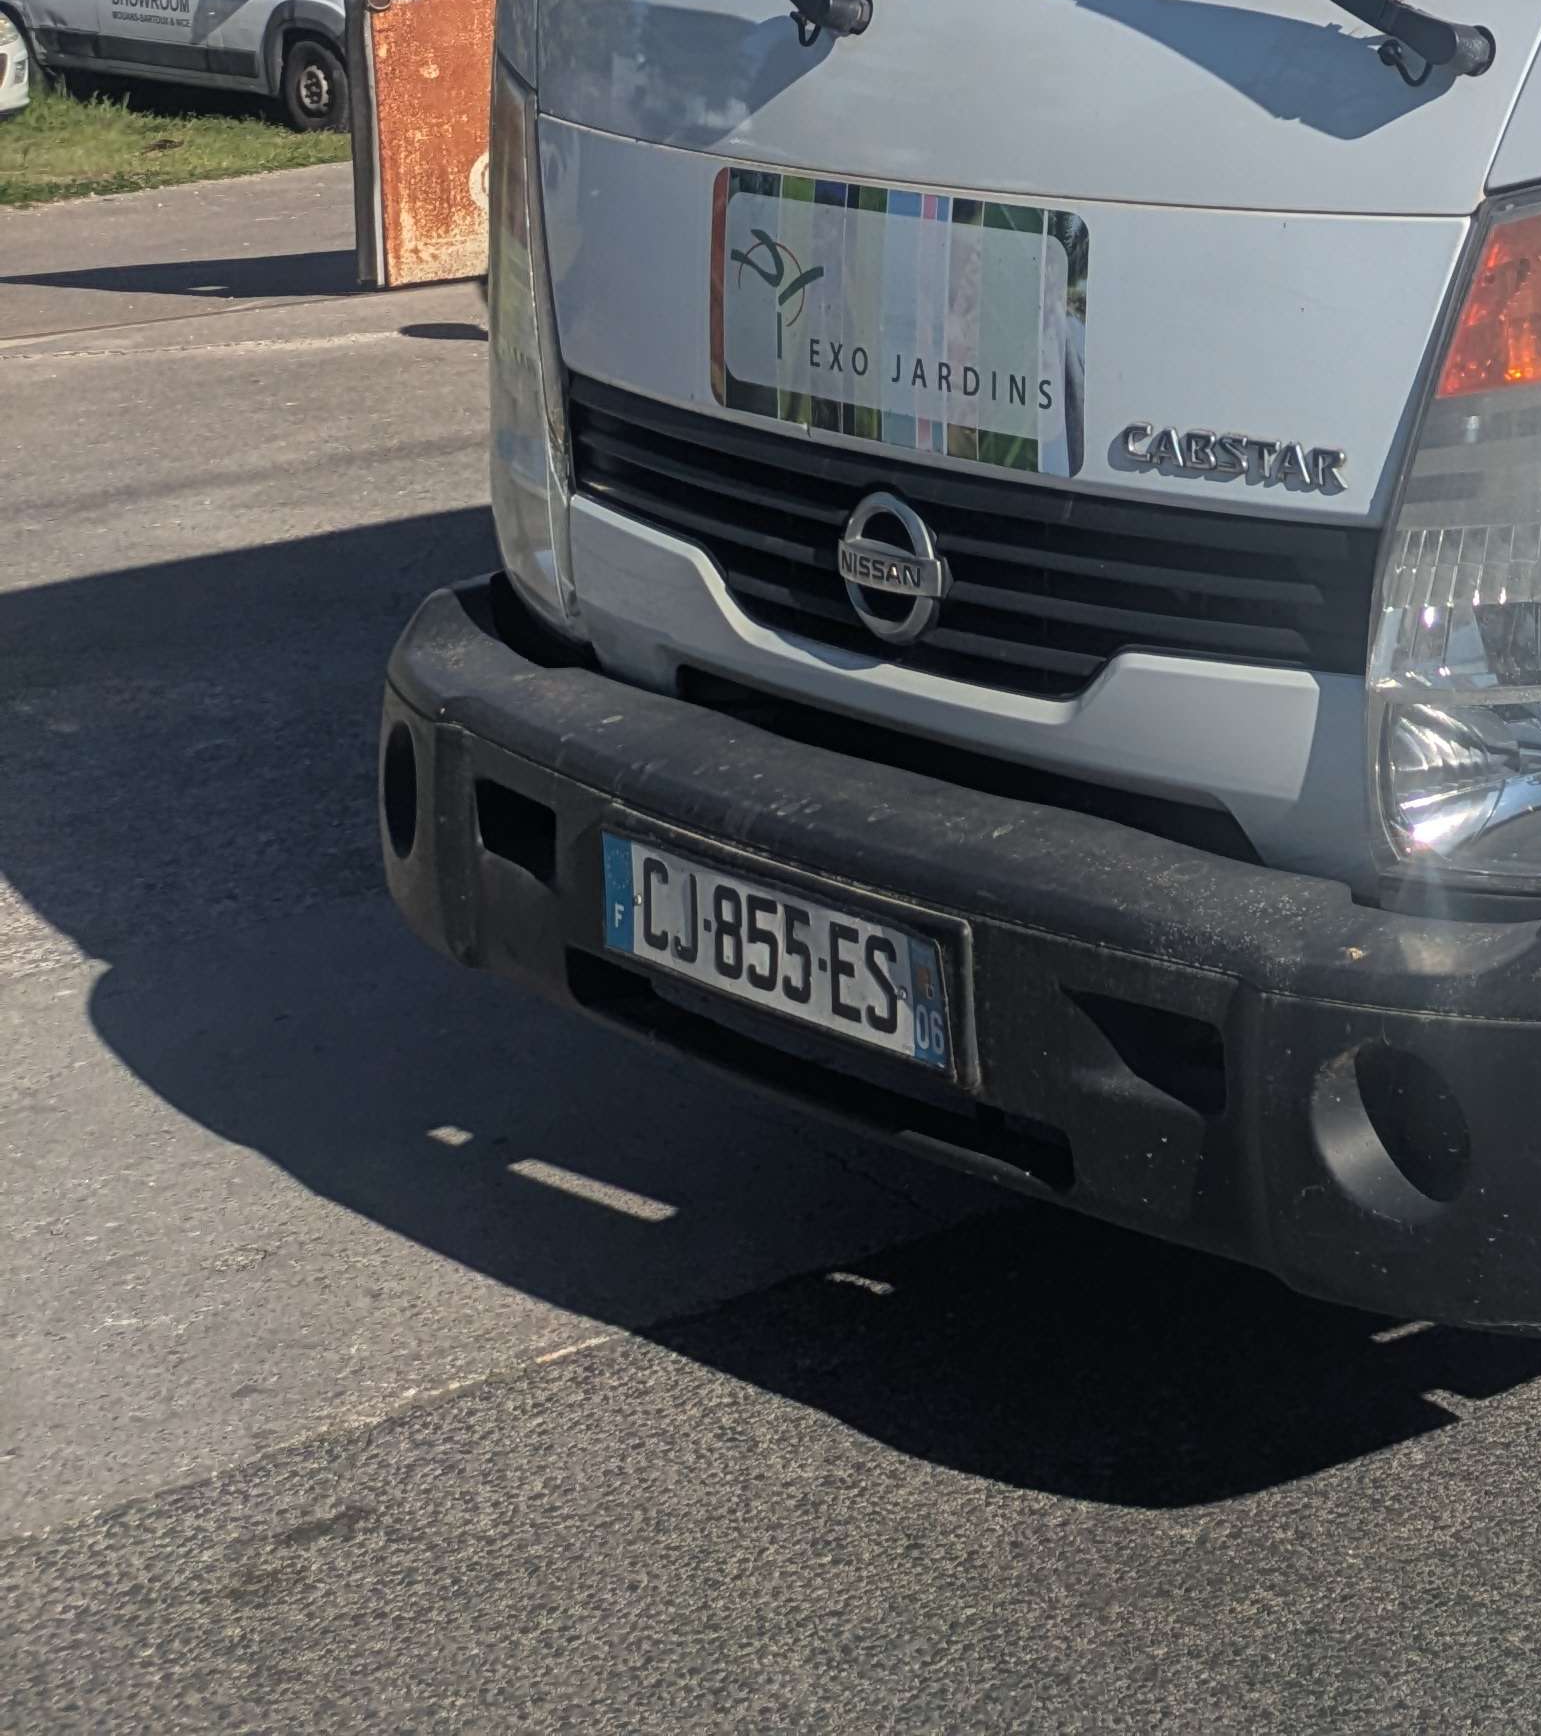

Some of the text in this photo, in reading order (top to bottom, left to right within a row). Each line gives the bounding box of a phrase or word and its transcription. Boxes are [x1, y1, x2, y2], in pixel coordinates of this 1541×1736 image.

[809, 338, 1054, 411] EXO JARDINS
[1122, 422, 1349, 490] CABSTAR
[841, 548, 921, 589] NISSAN
[614, 902, 625, 929] F
[915, 1003, 945, 1053] 06
